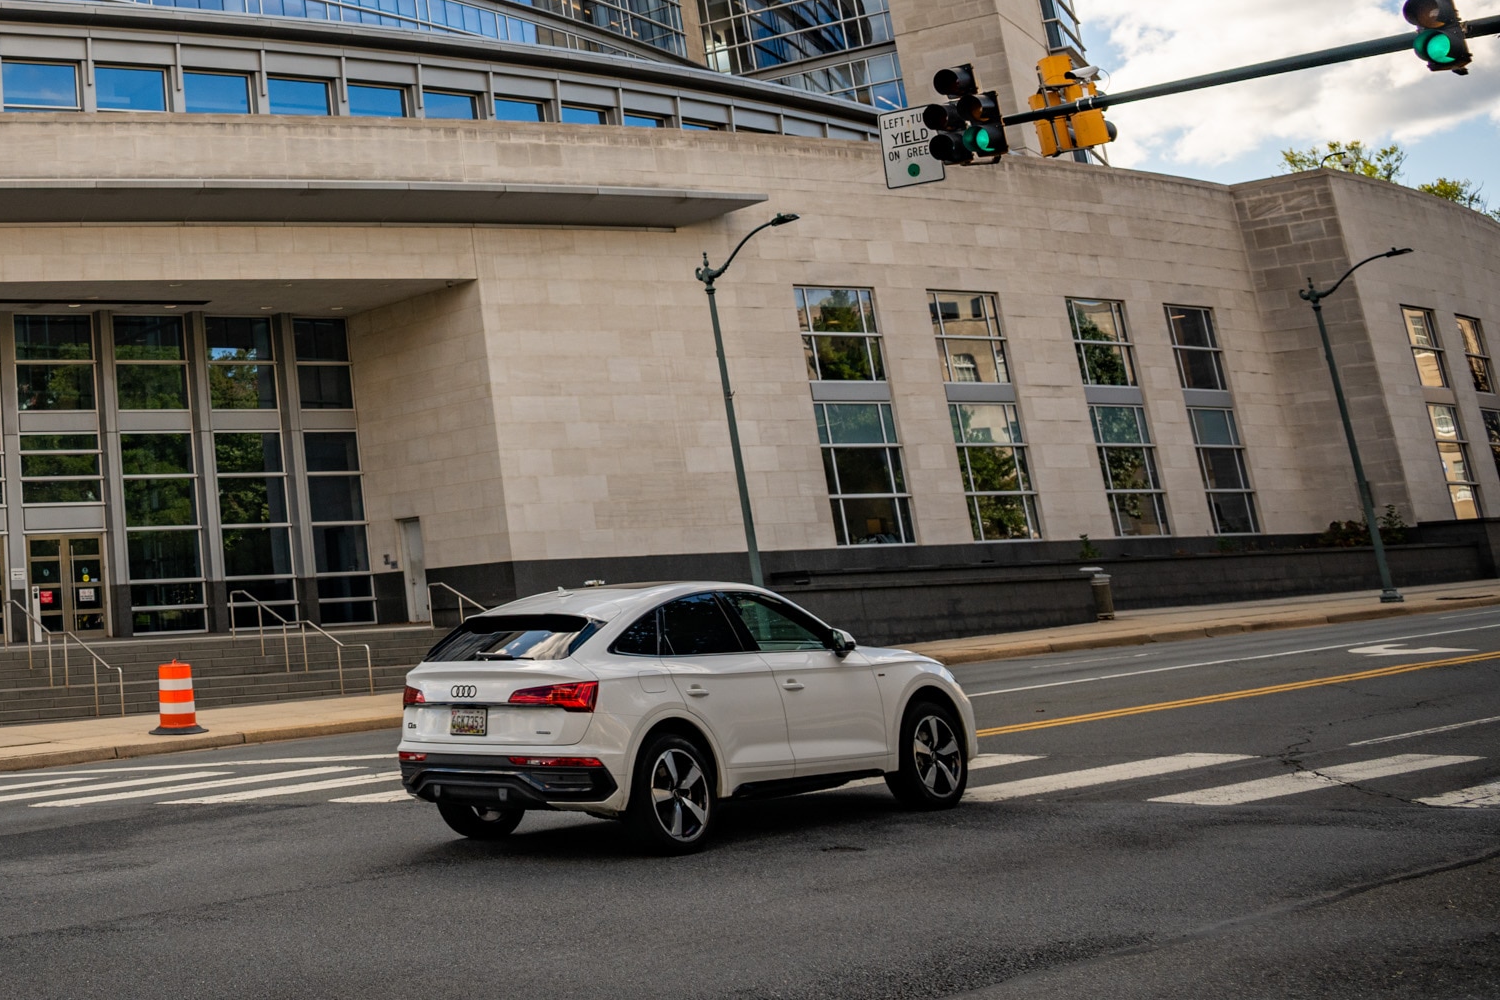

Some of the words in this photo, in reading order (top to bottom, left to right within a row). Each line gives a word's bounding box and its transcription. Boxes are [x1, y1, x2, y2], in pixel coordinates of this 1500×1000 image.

[883, 116, 904, 130] LEFT
[910, 113, 924, 124] TU
[891, 128, 929, 145] YIELD
[888, 150, 900, 162] ON
[907, 145, 930, 158] GREE
